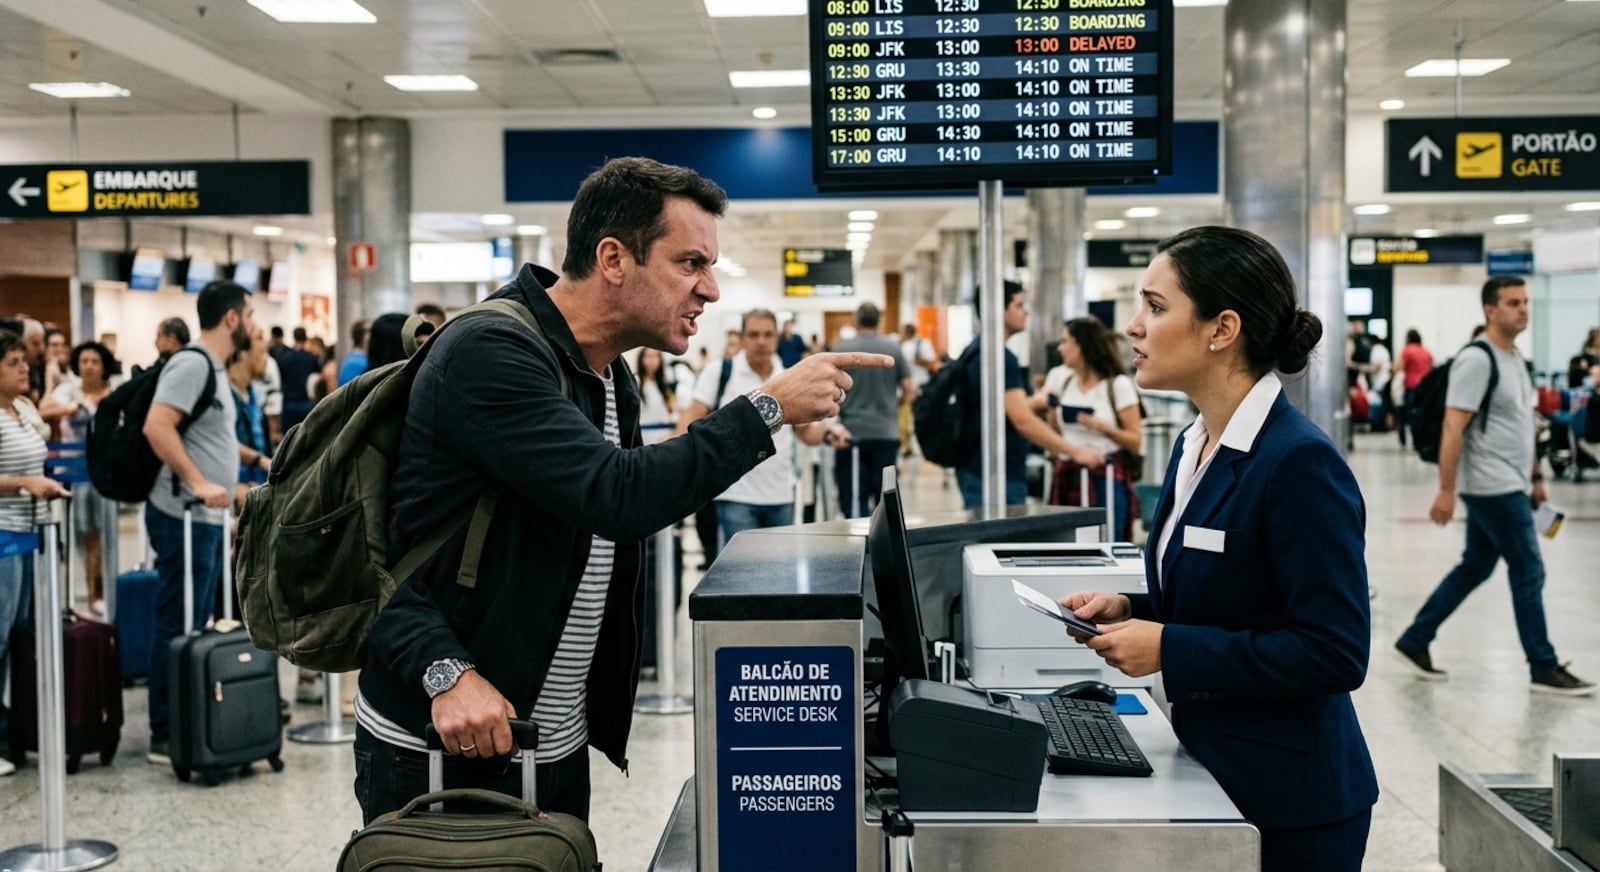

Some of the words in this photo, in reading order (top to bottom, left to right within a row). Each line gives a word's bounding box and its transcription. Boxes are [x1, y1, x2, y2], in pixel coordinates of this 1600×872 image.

[827, 0, 870, 15] 08:00
[875, 0, 904, 14] LIS
[935, 0, 980, 12] 12:30
[828, 21, 870, 36] 09:00
[875, 20, 904, 35] LIS
[935, 18, 980, 34] 12:30
[1015, 16, 1060, 31] 12:30
[1069, 13, 1146, 30] BOARDING
[828, 42, 870, 58] 09:00
[875, 41, 905, 57] JFK
[935, 39, 980, 56] 13:00
[1015, 37, 1060, 53] 13:00
[1069, 35, 1136, 51] DELAYED
[875, 62, 906, 78] GRU
[935, 60, 980, 77] 13:30
[1015, 59, 1060, 75] 14:10
[1069, 58, 1091, 74] ON
[1094, 57, 1134, 73] TIME
[829, 85, 871, 100] 13:30
[876, 84, 906, 99] JFK
[936, 82, 980, 98] 13:00
[1015, 80, 1060, 96] 14:10
[1069, 79, 1091, 95] ON
[1094, 78, 1134, 94] TIME
[830, 106, 872, 122] 13:30
[876, 105, 907, 120] JFK
[936, 103, 981, 119] 13:00
[1015, 101, 1061, 117] 14:10
[1069, 100, 1091, 116] ON
[1094, 99, 1134, 115] TIME
[830, 127, 872, 143] 15:00
[876, 126, 907, 142] GRU
[936, 125, 981, 140] 14:30
[1015, 123, 1061, 138] 14:10
[1069, 121, 1091, 137] ON
[1094, 120, 1134, 136] TIME
[1511, 130, 1597, 153] PORTÃO
[830, 149, 872, 164] 17:00
[876, 147, 907, 163] GRU
[936, 146, 982, 161] 14:10
[1015, 144, 1061, 160] 14:10
[1069, 143, 1091, 159] ON
[1094, 142, 1134, 158] TIME
[1511, 158, 1562, 177] GATE
[94, 170, 198, 190] EMBARQUE
[94, 191, 200, 210] DEPARTURES
[741, 660, 804, 681] BALCÃO
[808, 664, 830, 680] DE
[729, 684, 842, 702] ATENDIMENTO
[734, 706, 795, 722] SERVICE
[799, 706, 838, 722] DESK
[731, 774, 842, 792] PASSAGEIROS
[740, 796, 835, 812] PASSENGERS
